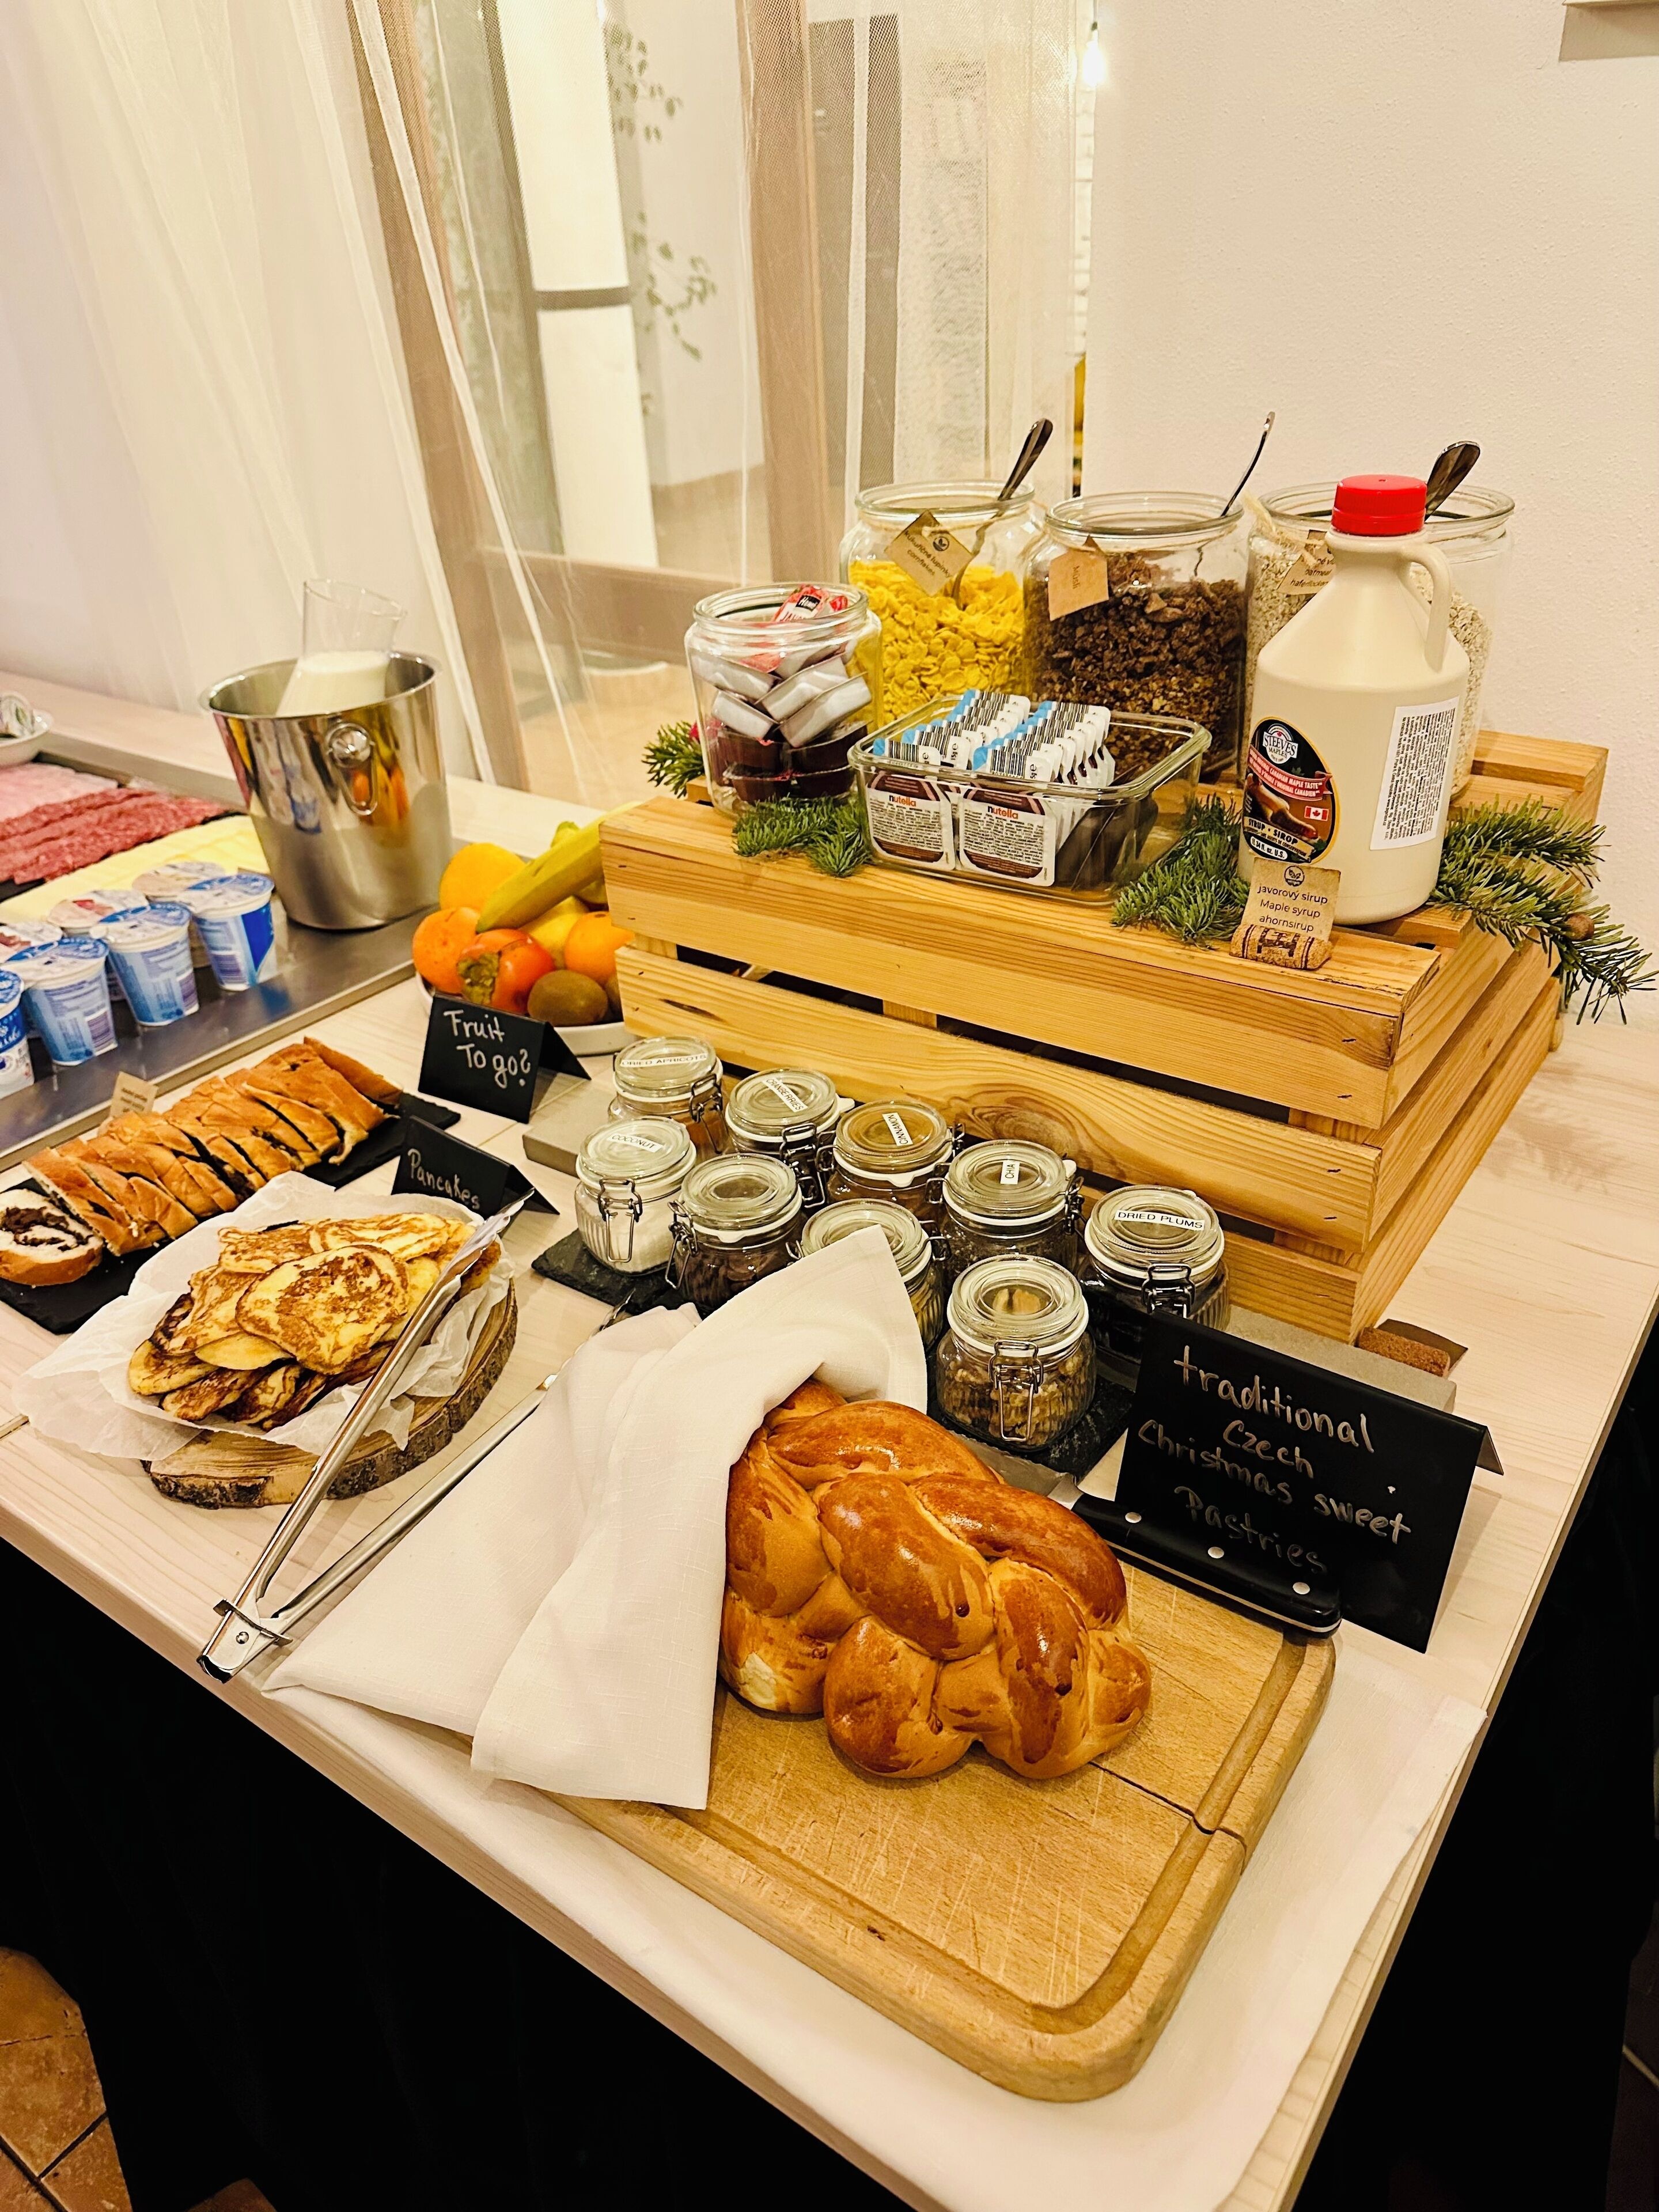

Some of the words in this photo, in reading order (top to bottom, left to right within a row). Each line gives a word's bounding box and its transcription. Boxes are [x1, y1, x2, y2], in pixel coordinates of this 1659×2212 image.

[1264, 734, 1296, 756] STEEVES
[1268, 747, 1287, 759] MAPLES
[1288, 776, 1304, 787] MAPLE
[889, 795, 916, 806] nutella
[988, 806, 1018, 819] nutella
[1248, 819, 1266, 831] SYRUP
[1273, 829, 1298, 845] SIROP
[1301, 892, 1328, 905] sirup
[1260, 899, 1290, 912] Maple
[1292, 907, 1320, 919] syrup
[1259, 915, 1314, 932] ahornsirup
[443, 1009, 505, 1042] Fruit
[656, 1054, 707, 1064] APRICOTS
[887, 1114, 908, 1145] CINNAMON
[612, 1135, 656, 1149] COCONUT
[408, 1148, 480, 1210] Pancakes
[1005, 1164, 1015, 1179] CHIA
[1118, 1212, 1156, 1220] DRIED
[1160, 1215, 1203, 1229] PLUMS
[1174, 1344, 1374, 1453] traditional
[1223, 1419, 1314, 1479] Czech
[1138, 1419, 1293, 1505] Christmas
